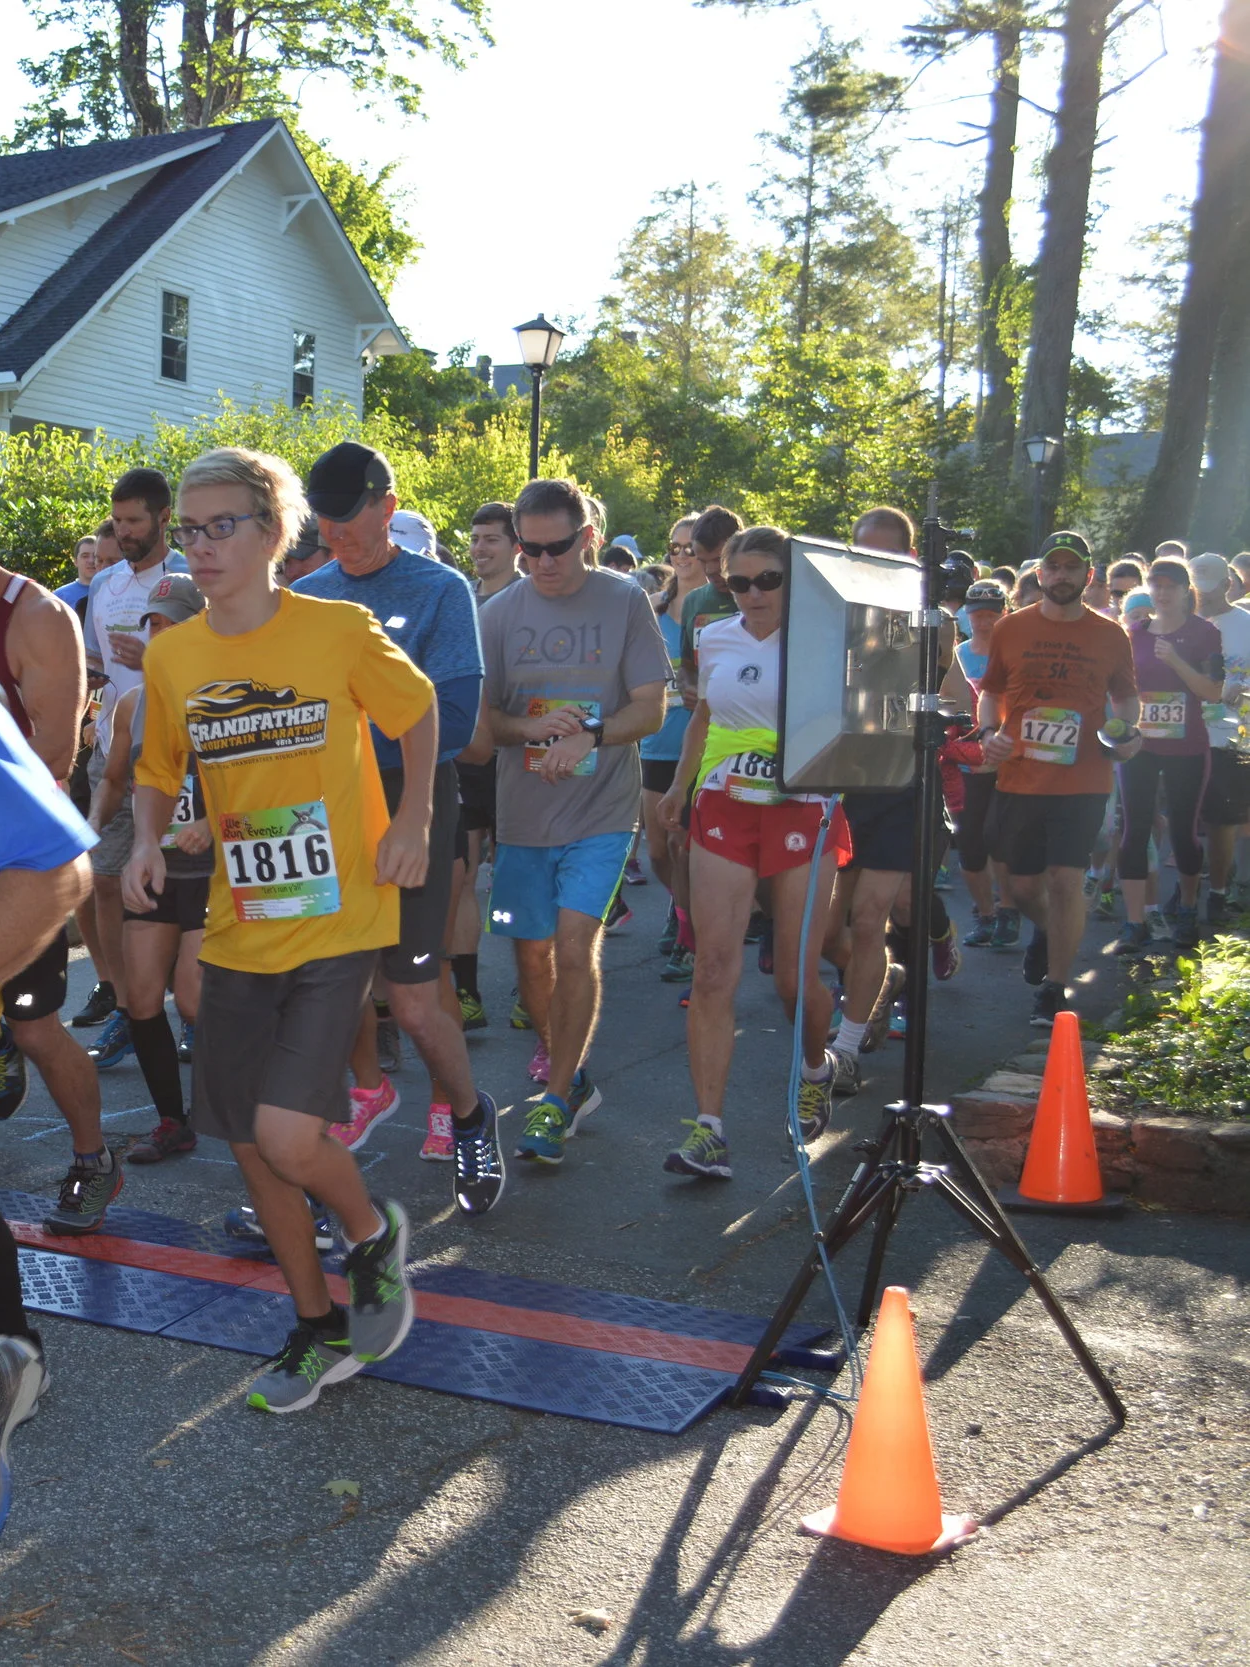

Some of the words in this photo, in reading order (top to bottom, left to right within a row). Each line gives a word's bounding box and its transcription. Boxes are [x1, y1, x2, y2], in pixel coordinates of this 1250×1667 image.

[513, 622, 602, 666] 2011
[188, 702, 327, 752] GRANDFATHER
[201, 733, 257, 752] MOUNTAIN
[261, 721, 325, 742] MARATHON
[1023, 720, 1078, 746] 1772
[223, 828, 245, 841] Run
[247, 825, 284, 838] Events
[225, 818, 241, 829] We
[230, 833, 331, 885] 1816
